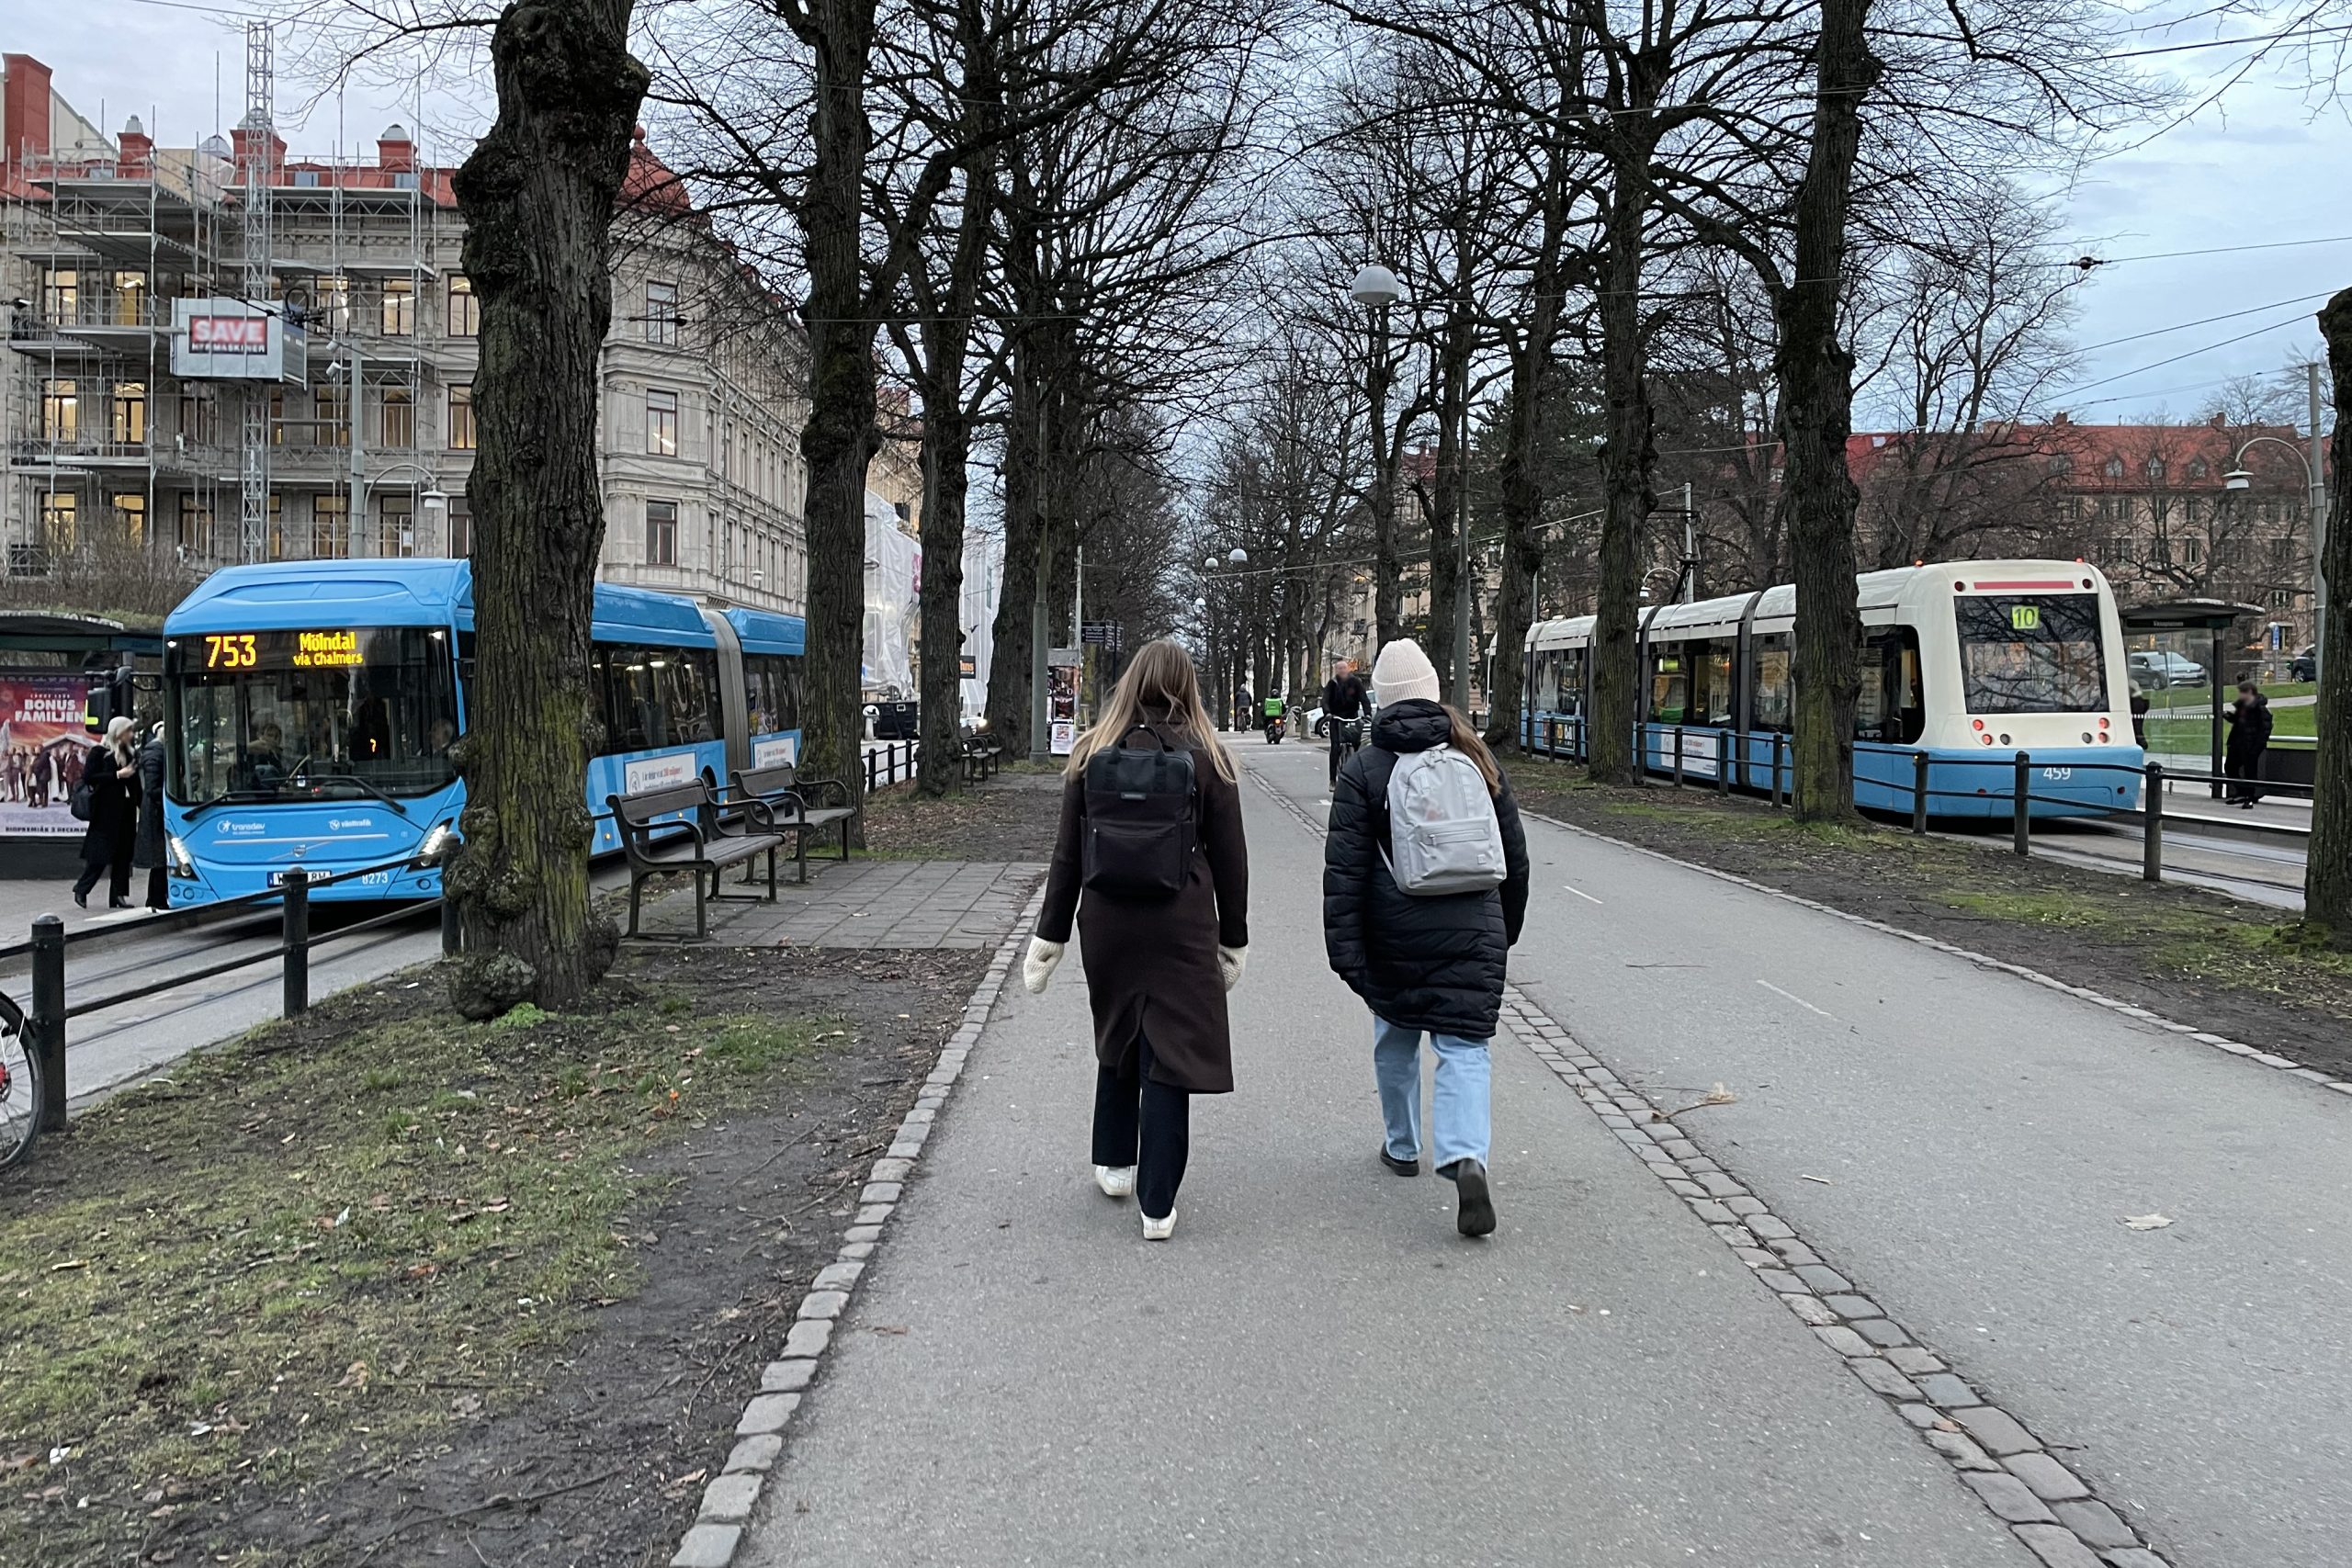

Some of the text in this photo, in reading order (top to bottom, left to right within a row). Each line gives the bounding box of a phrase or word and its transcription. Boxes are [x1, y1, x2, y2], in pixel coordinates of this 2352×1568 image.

[194, 320, 265, 342] SAVE
[2014, 607, 2036, 627] 10
[300, 631, 356, 651] Mölndal
[205, 634, 256, 668] 753
[293, 652, 363, 666] via Chalmers
[24, 699, 76, 711] BONUS
[15, 710, 85, 723] FAMILJEN
[2042, 766, 2072, 780] 459
